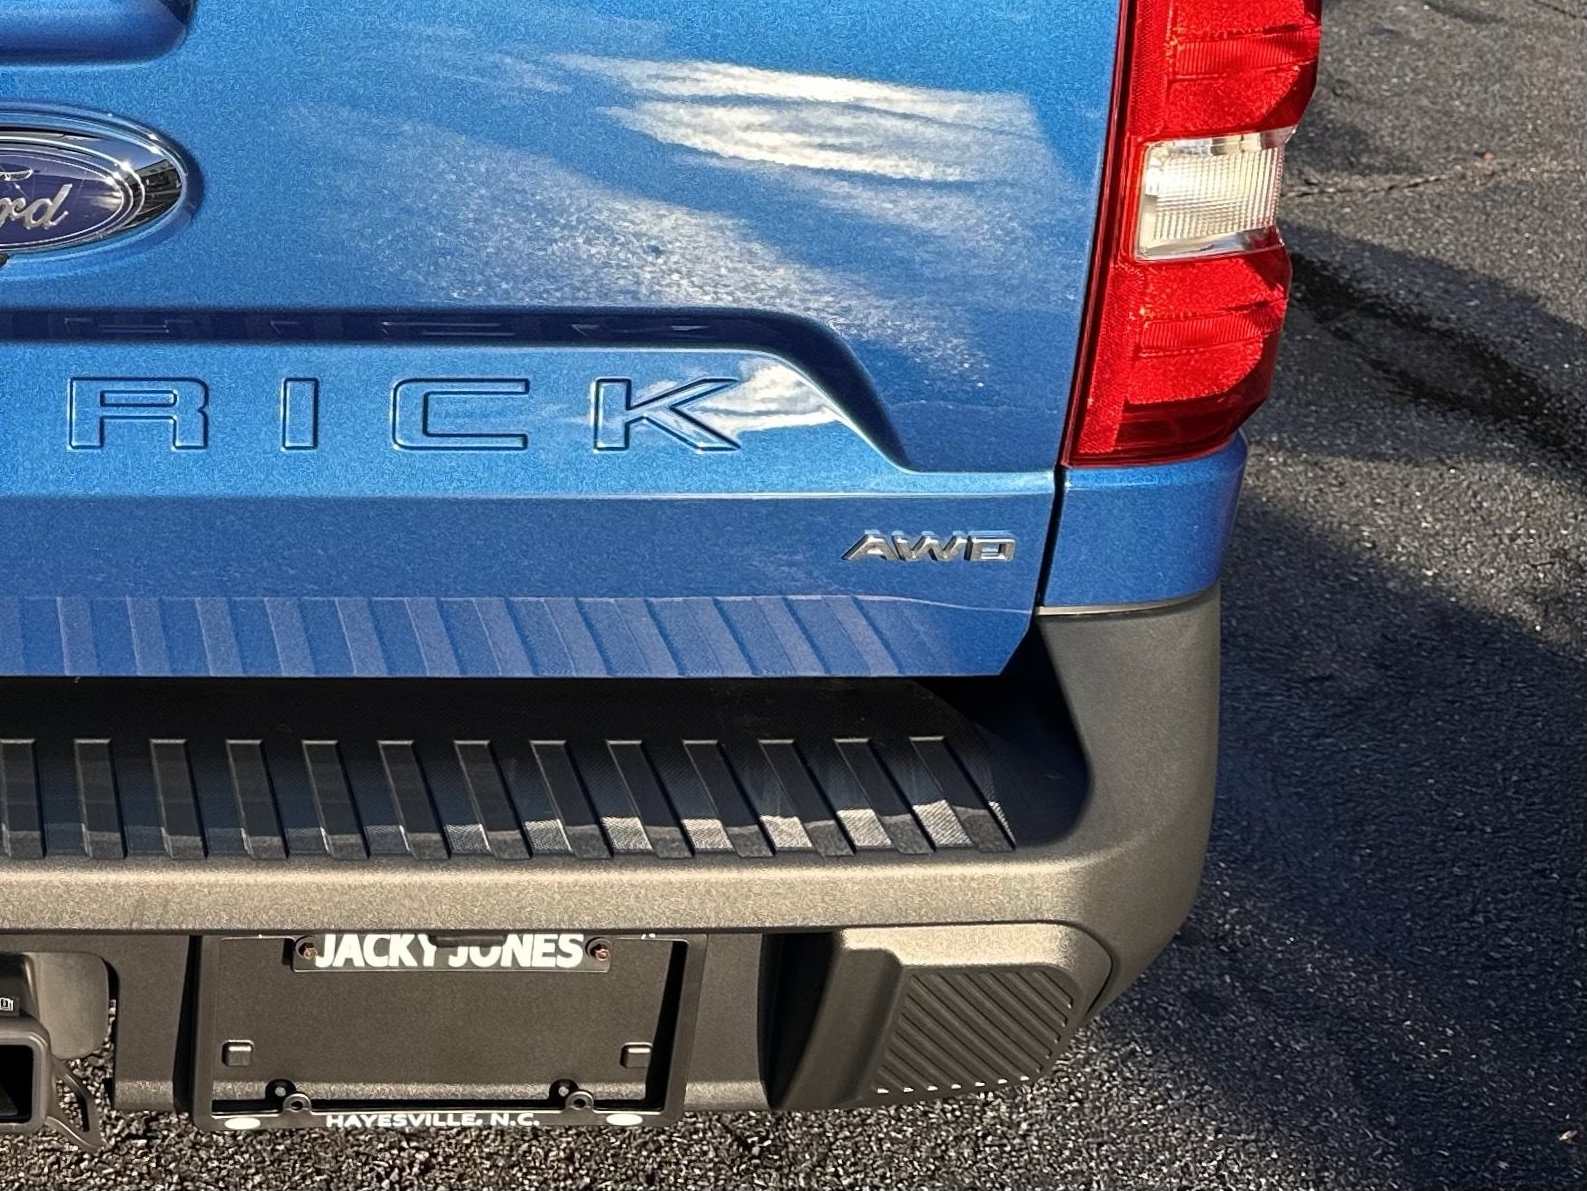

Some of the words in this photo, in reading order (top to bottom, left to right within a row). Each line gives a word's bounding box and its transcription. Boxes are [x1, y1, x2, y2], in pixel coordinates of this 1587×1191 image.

[841, 529, 1017, 562] AWD
[315, 933, 438, 968] JACKY
[448, 933, 584, 968] JONES
[326, 1112, 484, 1128] HAYESVILLE,
[490, 1112, 540, 1127] N.C.
